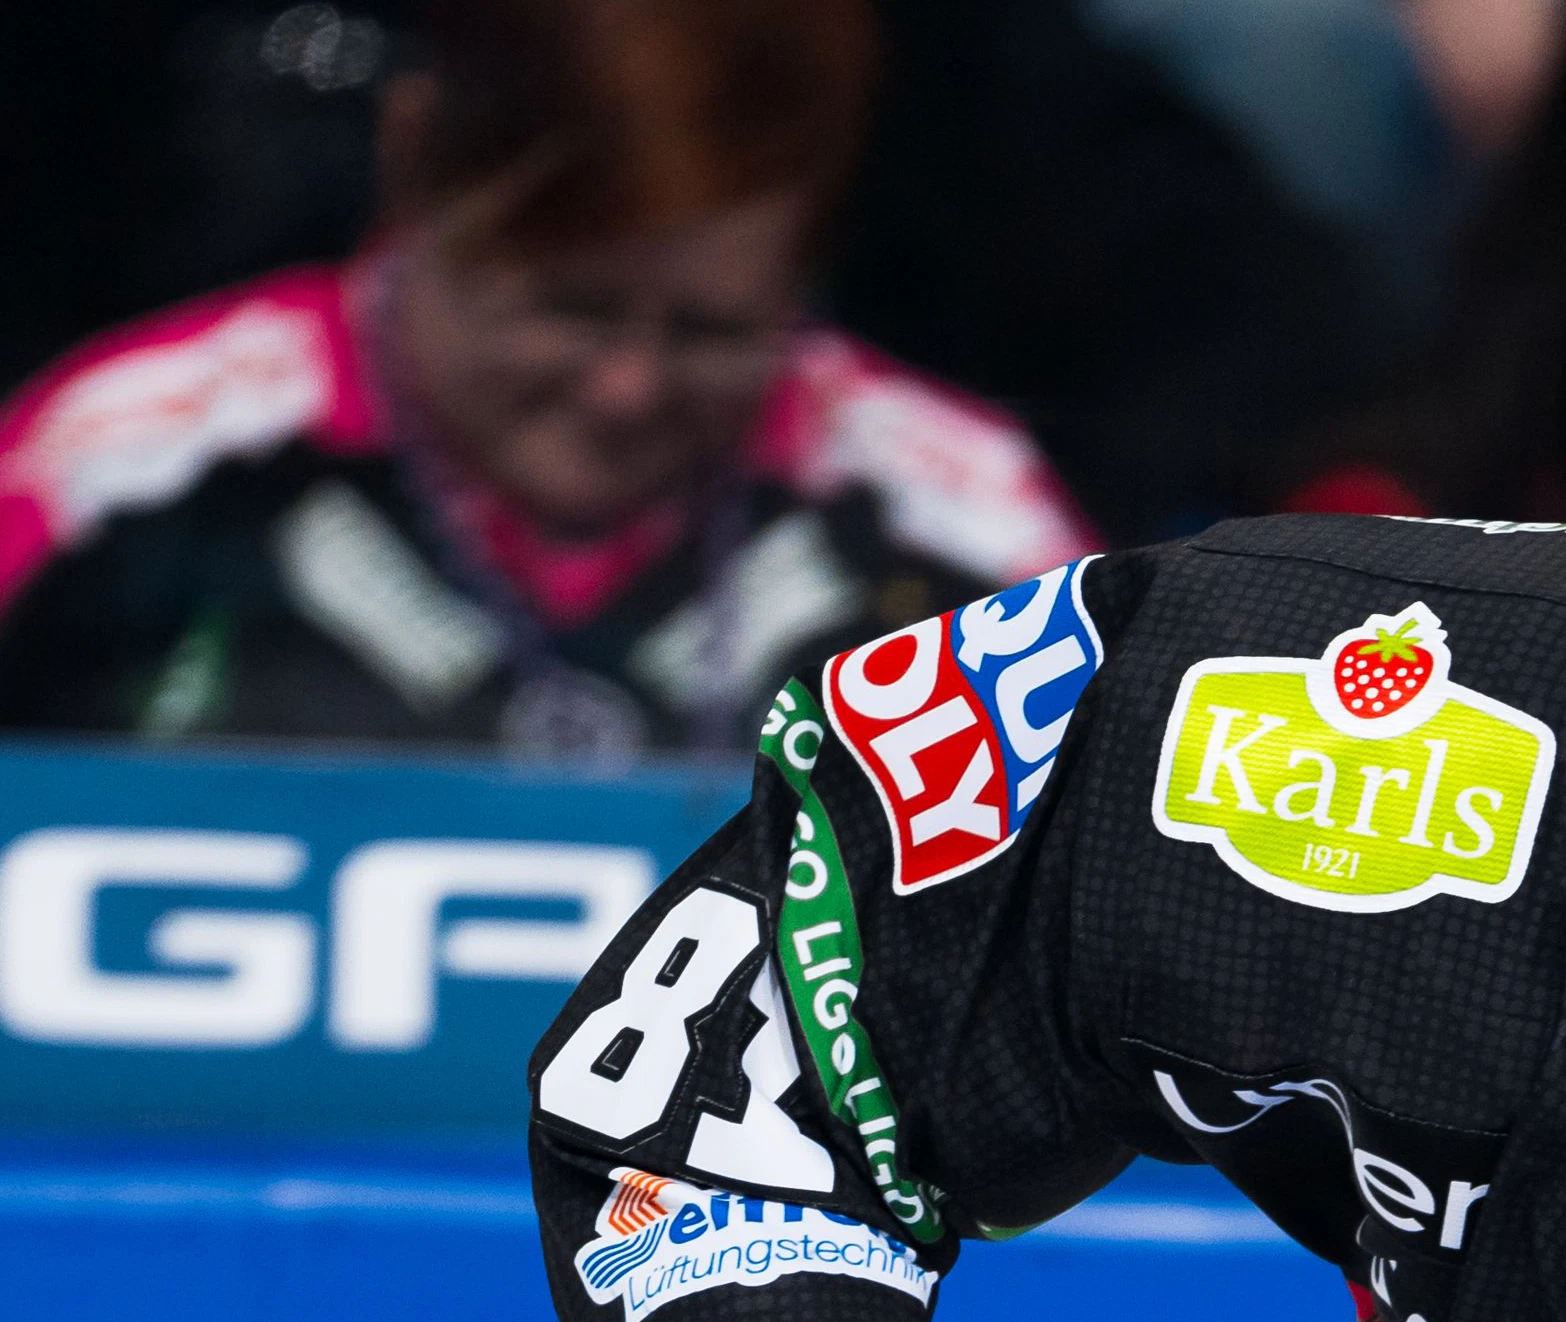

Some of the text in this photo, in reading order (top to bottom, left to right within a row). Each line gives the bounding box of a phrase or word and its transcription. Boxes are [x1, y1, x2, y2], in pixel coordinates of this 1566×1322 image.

[1185, 704, 1505, 859] Karls
[1301, 843, 1360, 879] 1921
[540, 887, 836, 1193] 81
